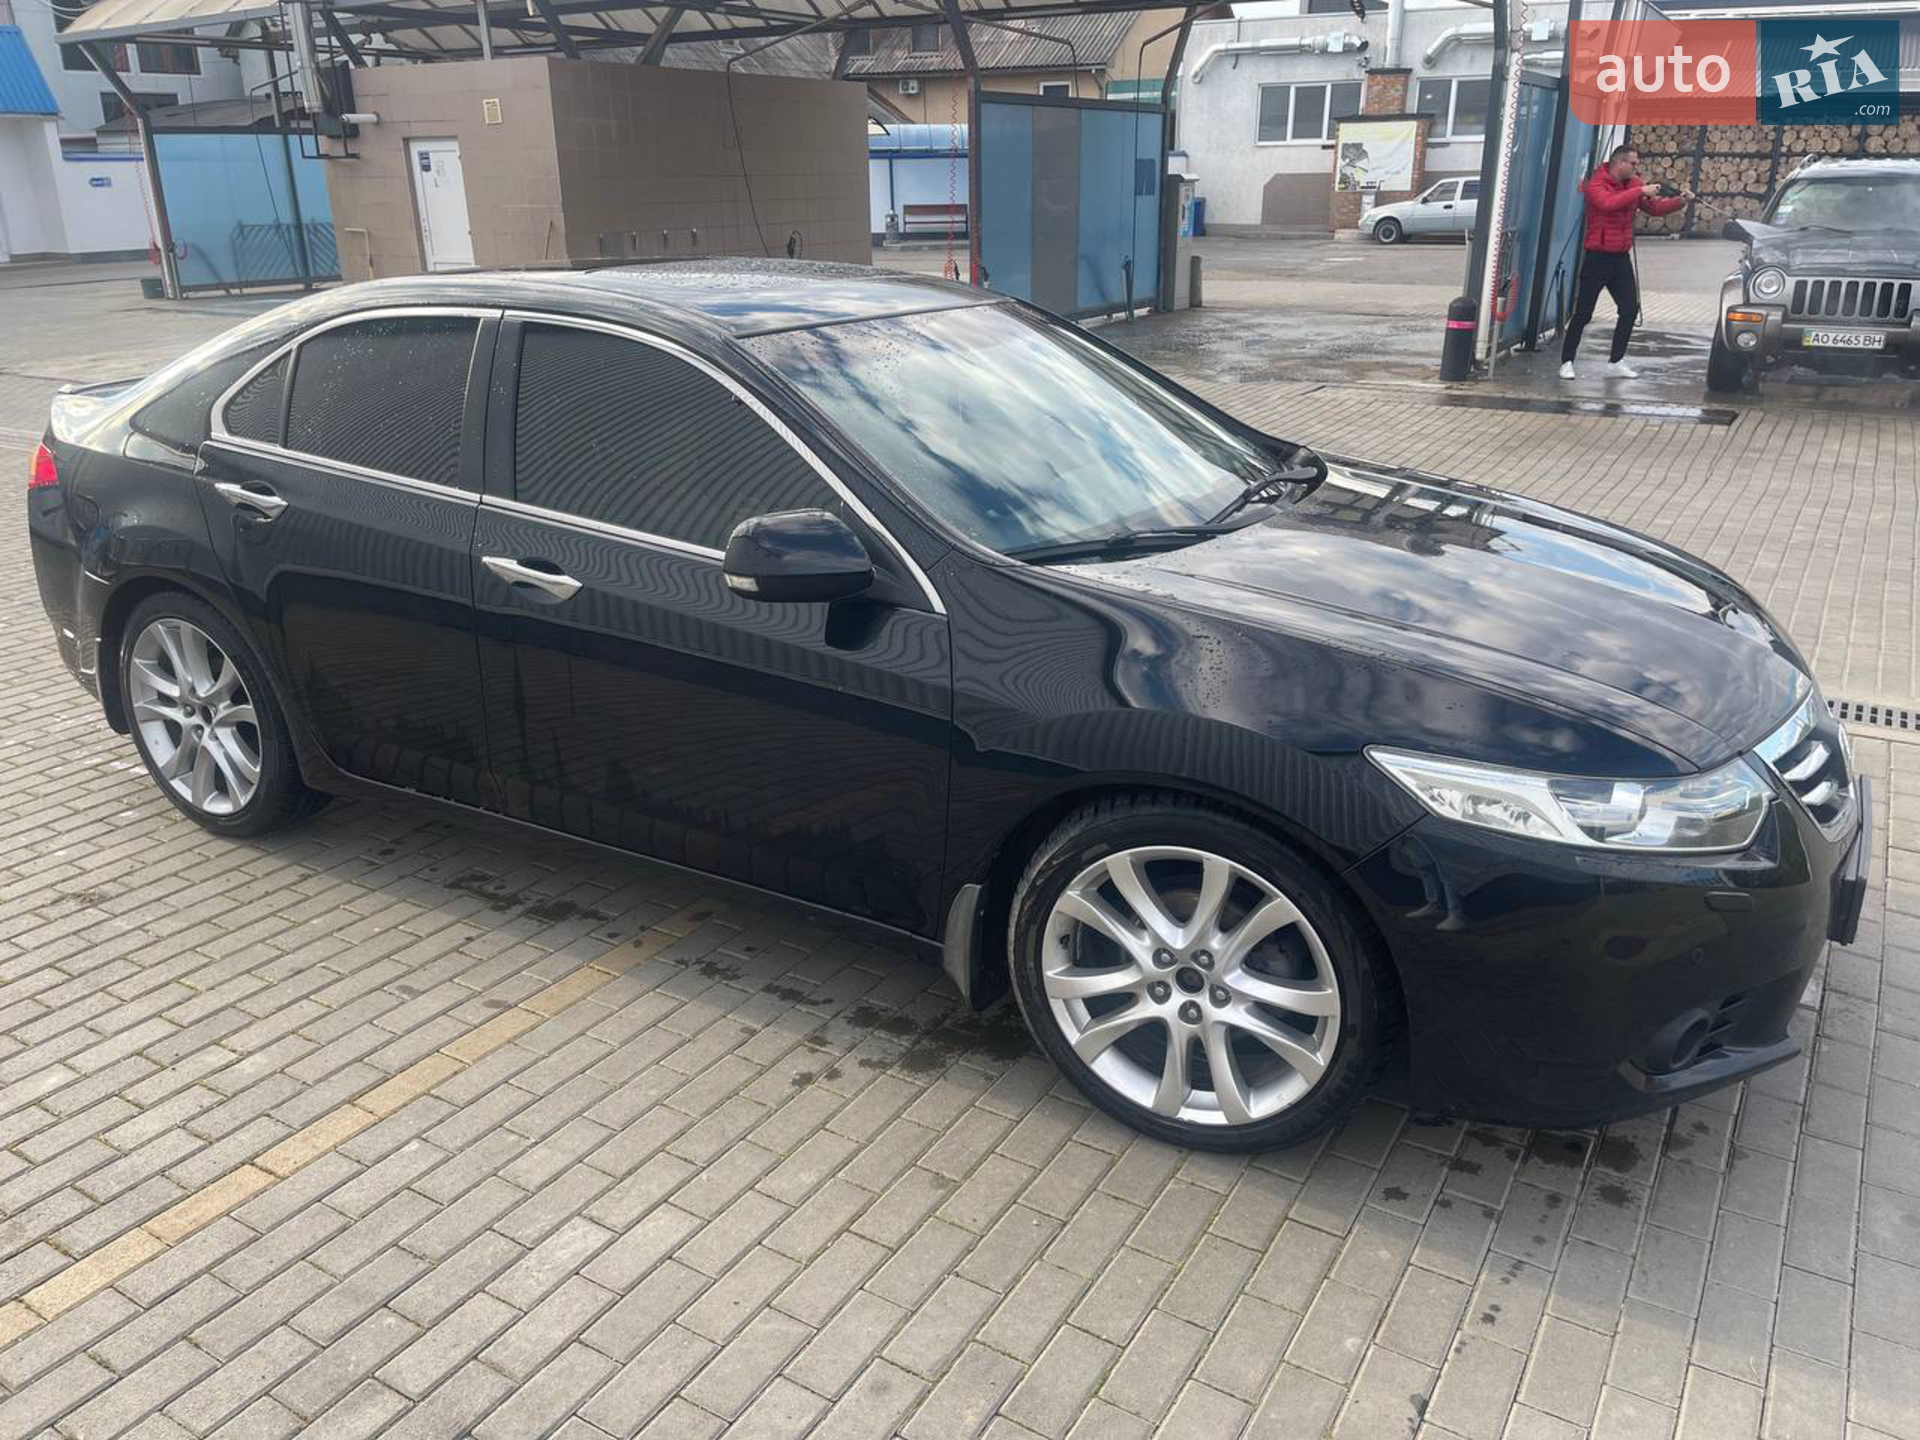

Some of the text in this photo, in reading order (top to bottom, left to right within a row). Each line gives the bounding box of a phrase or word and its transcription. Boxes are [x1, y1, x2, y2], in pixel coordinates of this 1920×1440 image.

[1812, 333, 1882, 348] AO 6465 BH
